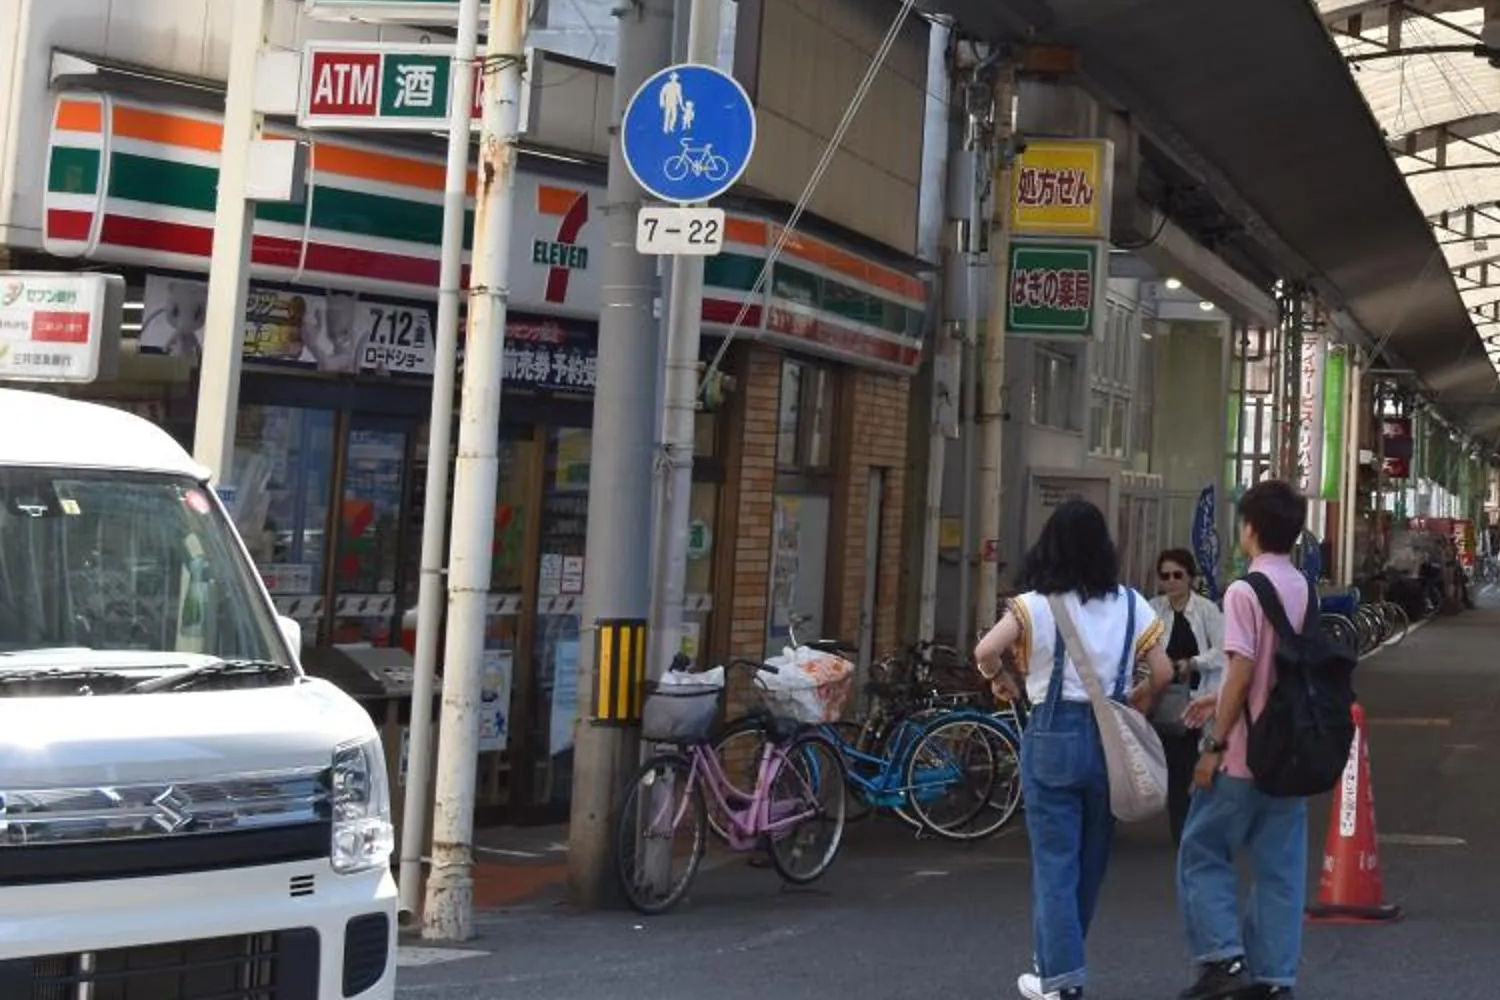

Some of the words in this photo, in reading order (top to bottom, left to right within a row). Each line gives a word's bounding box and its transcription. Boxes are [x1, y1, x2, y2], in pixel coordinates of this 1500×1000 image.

[314, 63, 375, 106] ATM
[393, 63, 437, 109] 酒
[1018, 169, 1093, 205] 処方せん
[369, 308, 412, 346] 7.12
[365, 348, 425, 368] ロードショー
